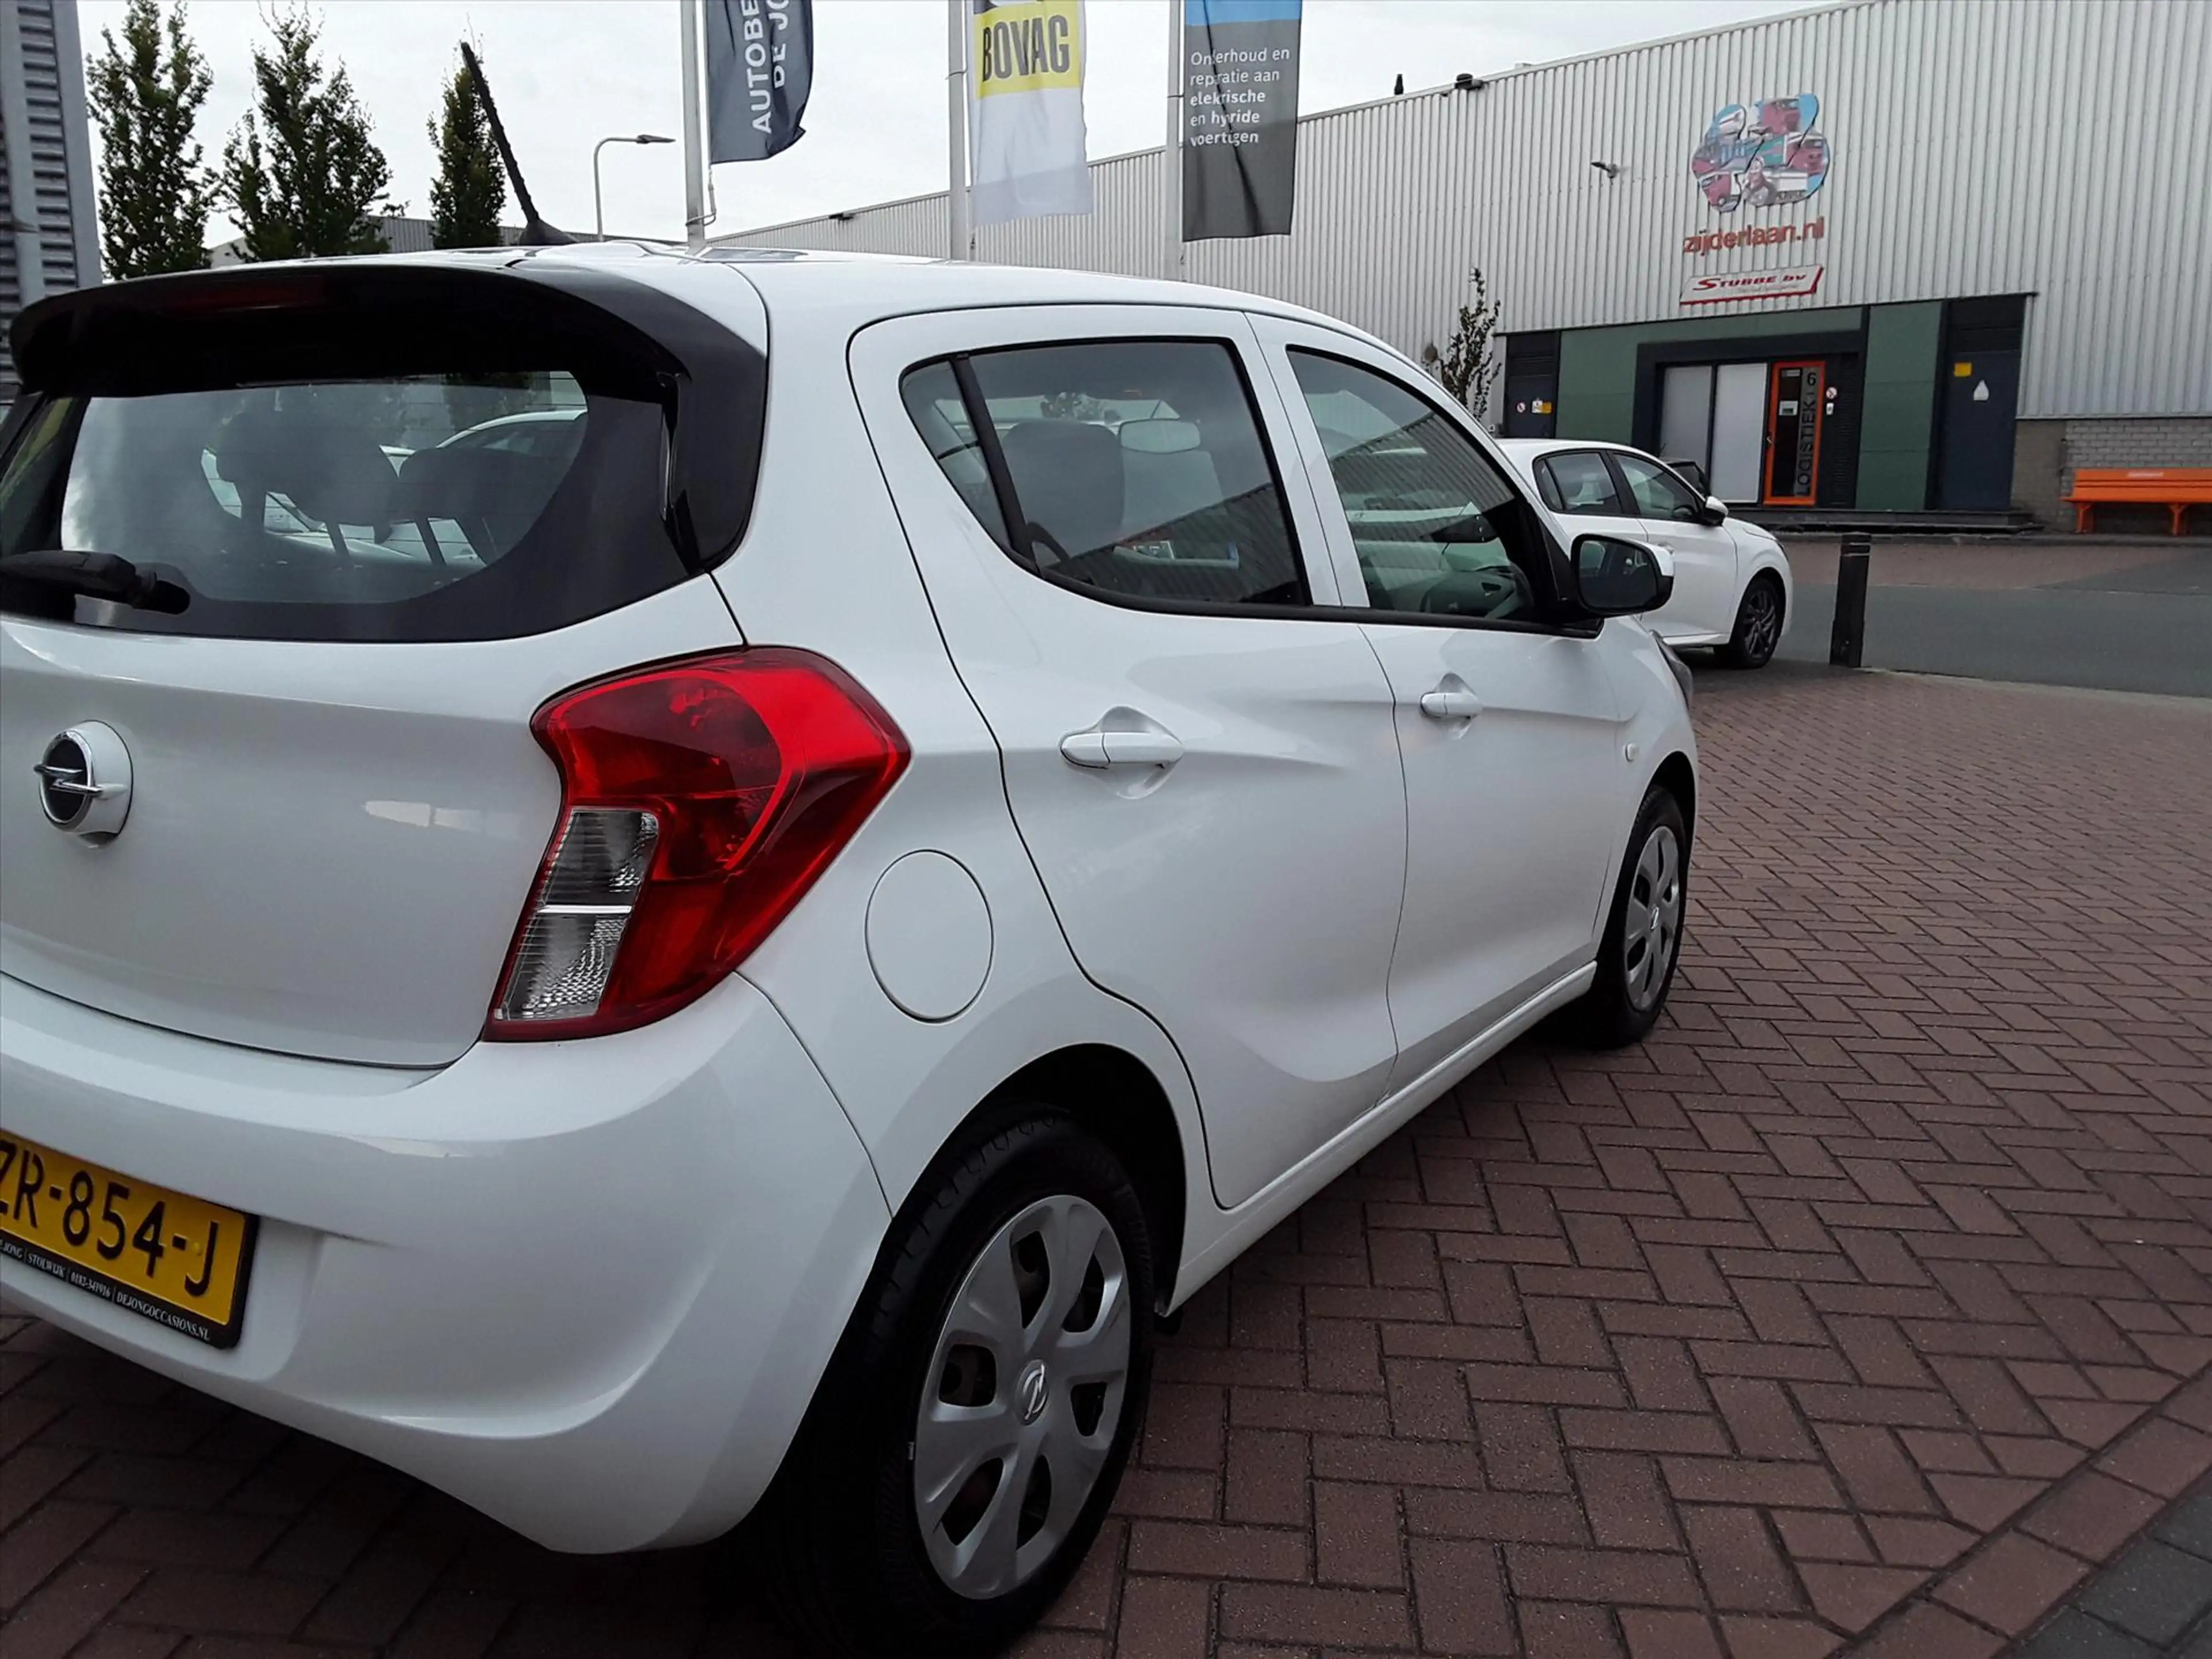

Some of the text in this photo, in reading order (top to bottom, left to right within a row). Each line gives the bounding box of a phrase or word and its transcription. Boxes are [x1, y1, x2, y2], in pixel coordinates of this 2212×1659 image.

[982, 14, 1070, 82] BOVAG
[1272, 48, 1290, 60] en
[771, 43, 786, 89] DE
[1190, 69, 1280, 88] repratie aan
[1190, 109, 1260, 127] en hyride
[1684, 215, 1825, 256] zijderlaan.nl
[1806, 372, 1816, 386] 6
